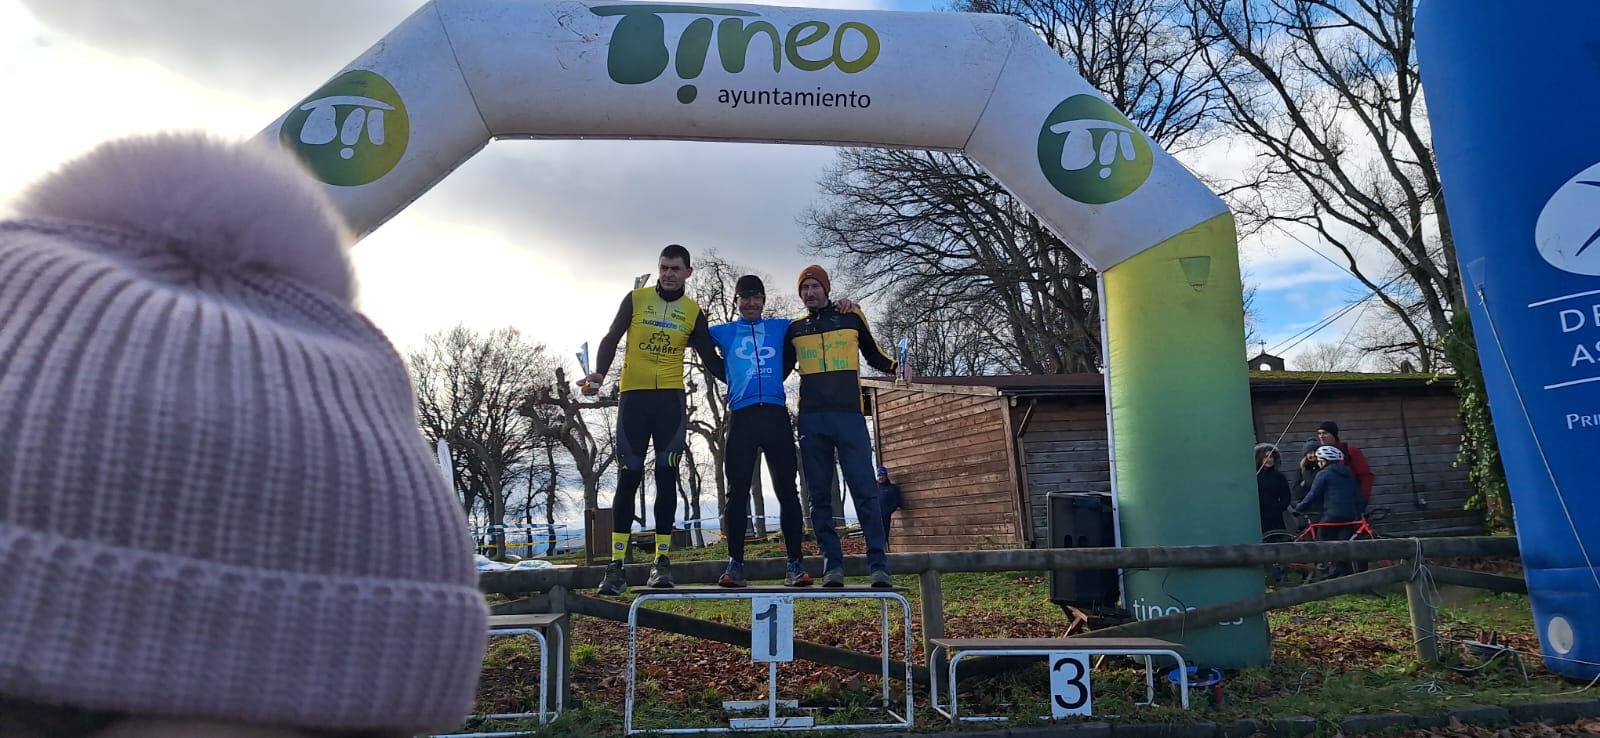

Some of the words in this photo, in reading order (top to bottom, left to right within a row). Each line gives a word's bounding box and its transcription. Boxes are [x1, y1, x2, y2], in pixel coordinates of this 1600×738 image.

[591, 4, 881, 104] Tineo
[717, 86, 871, 108] ayuntamiento
[1566, 413, 1600, 430] PRI
[755, 604, 778, 657] 1
[1053, 658, 1088, 710] 3
